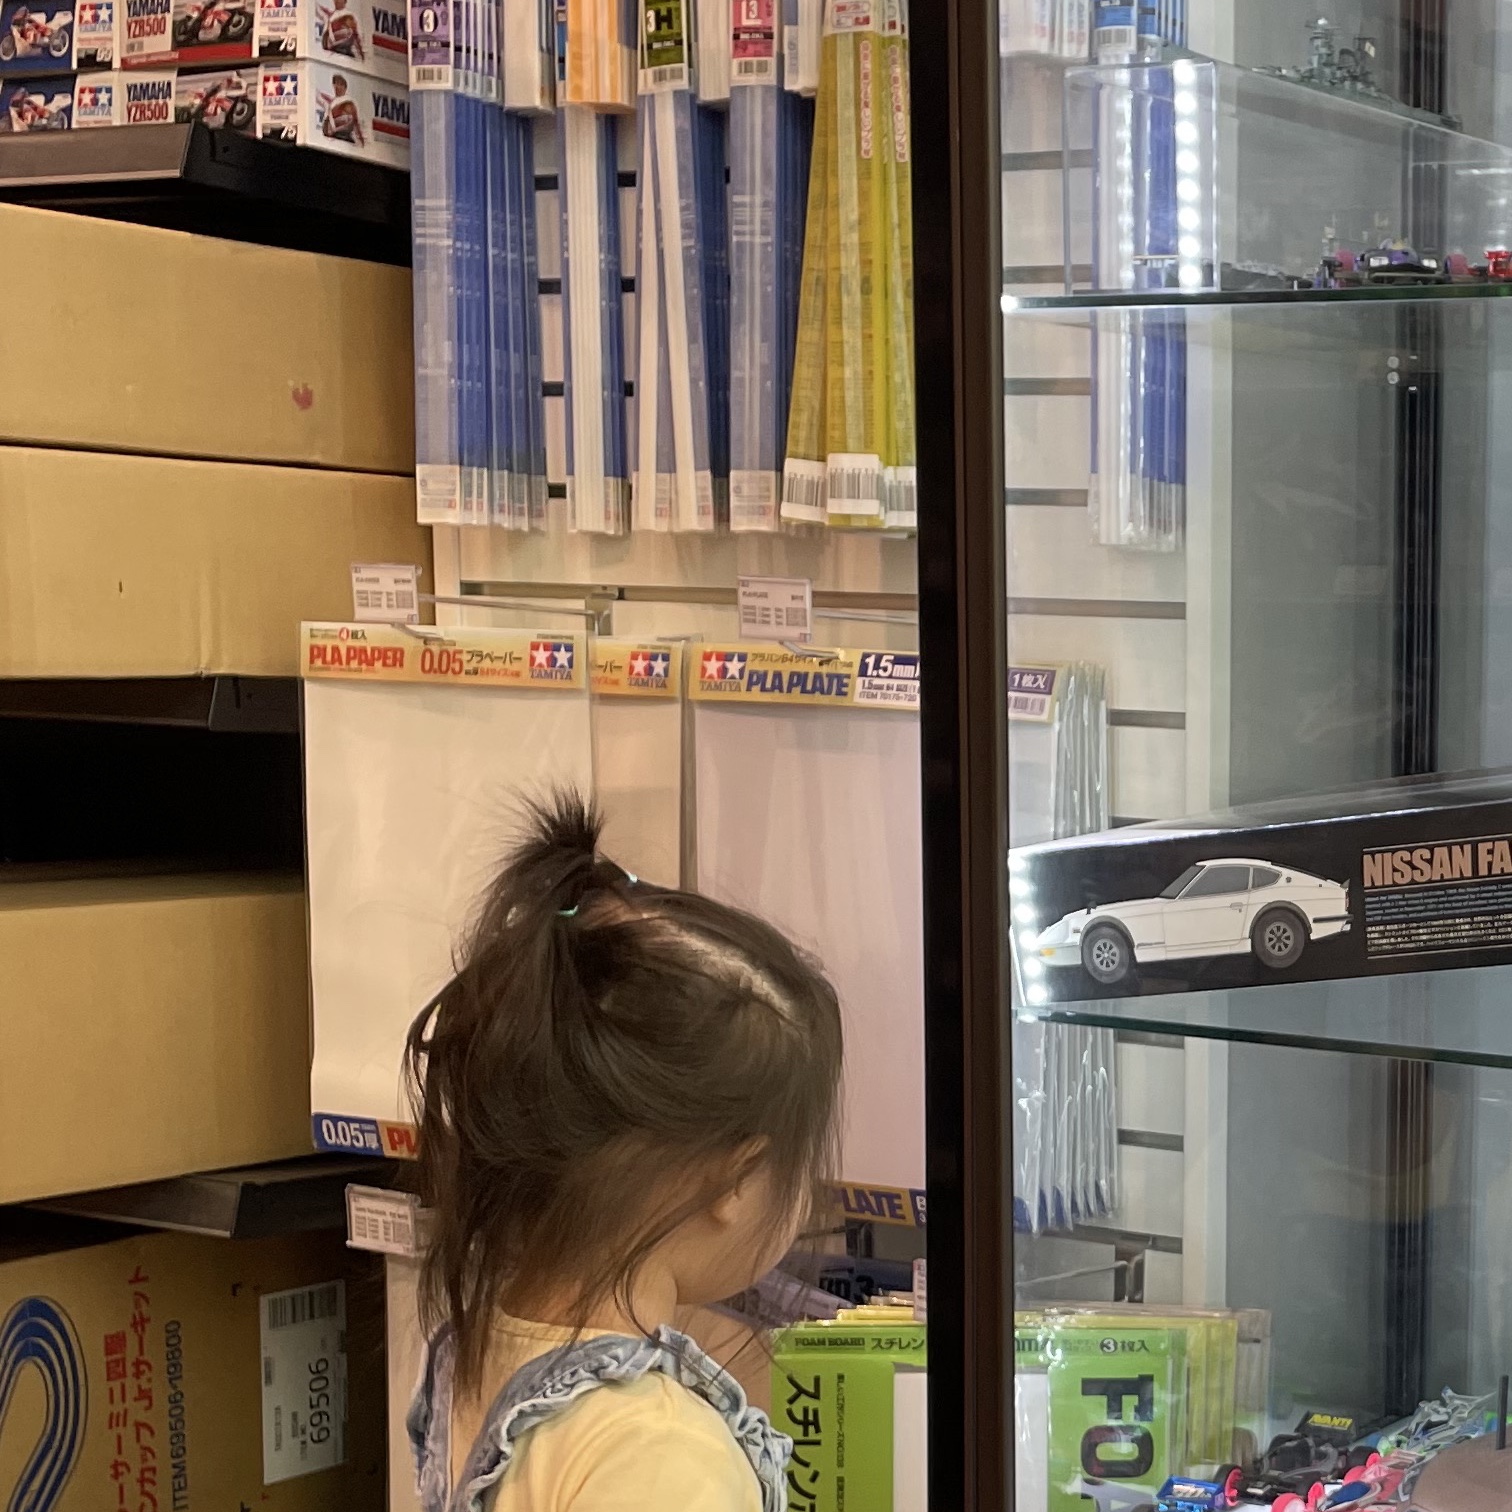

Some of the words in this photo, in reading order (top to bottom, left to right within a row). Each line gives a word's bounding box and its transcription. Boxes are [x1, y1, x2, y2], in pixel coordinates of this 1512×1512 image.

[127, 0, 171, 17] YAMAHA
[127, 18, 167, 39] YZR500
[372, 6, 408, 40] YAM
[127, 80, 172, 102] YAMAHA
[127, 101, 169, 123] YZR500
[372, 92, 410, 125] YAM
[309, 644, 343, 667] PLA
[345, 645, 404, 669] PAPER
[421, 648, 464, 676] 0.05
[865, 654, 919, 678] 1.5mm
[529, 669, 573, 681] TAMIYA
[627, 677, 667, 689] TAMIYA
[700, 680, 742, 693] TAMIYA
[746, 669, 785, 693] PLA
[786, 670, 851, 697] PLATE
[1363, 844, 1472, 888] NISSAN
[321, 1118, 364, 1148] 0.05
[386, 1126, 418, 1154] PL
[840, 1186, 906, 1220] LATE
[795, 1337, 827, 1348] FOAM
[828, 1338, 866, 1349] BOARD
[871, 1337, 925, 1351] スチレン
[308, 1357, 331, 1444] 69506
